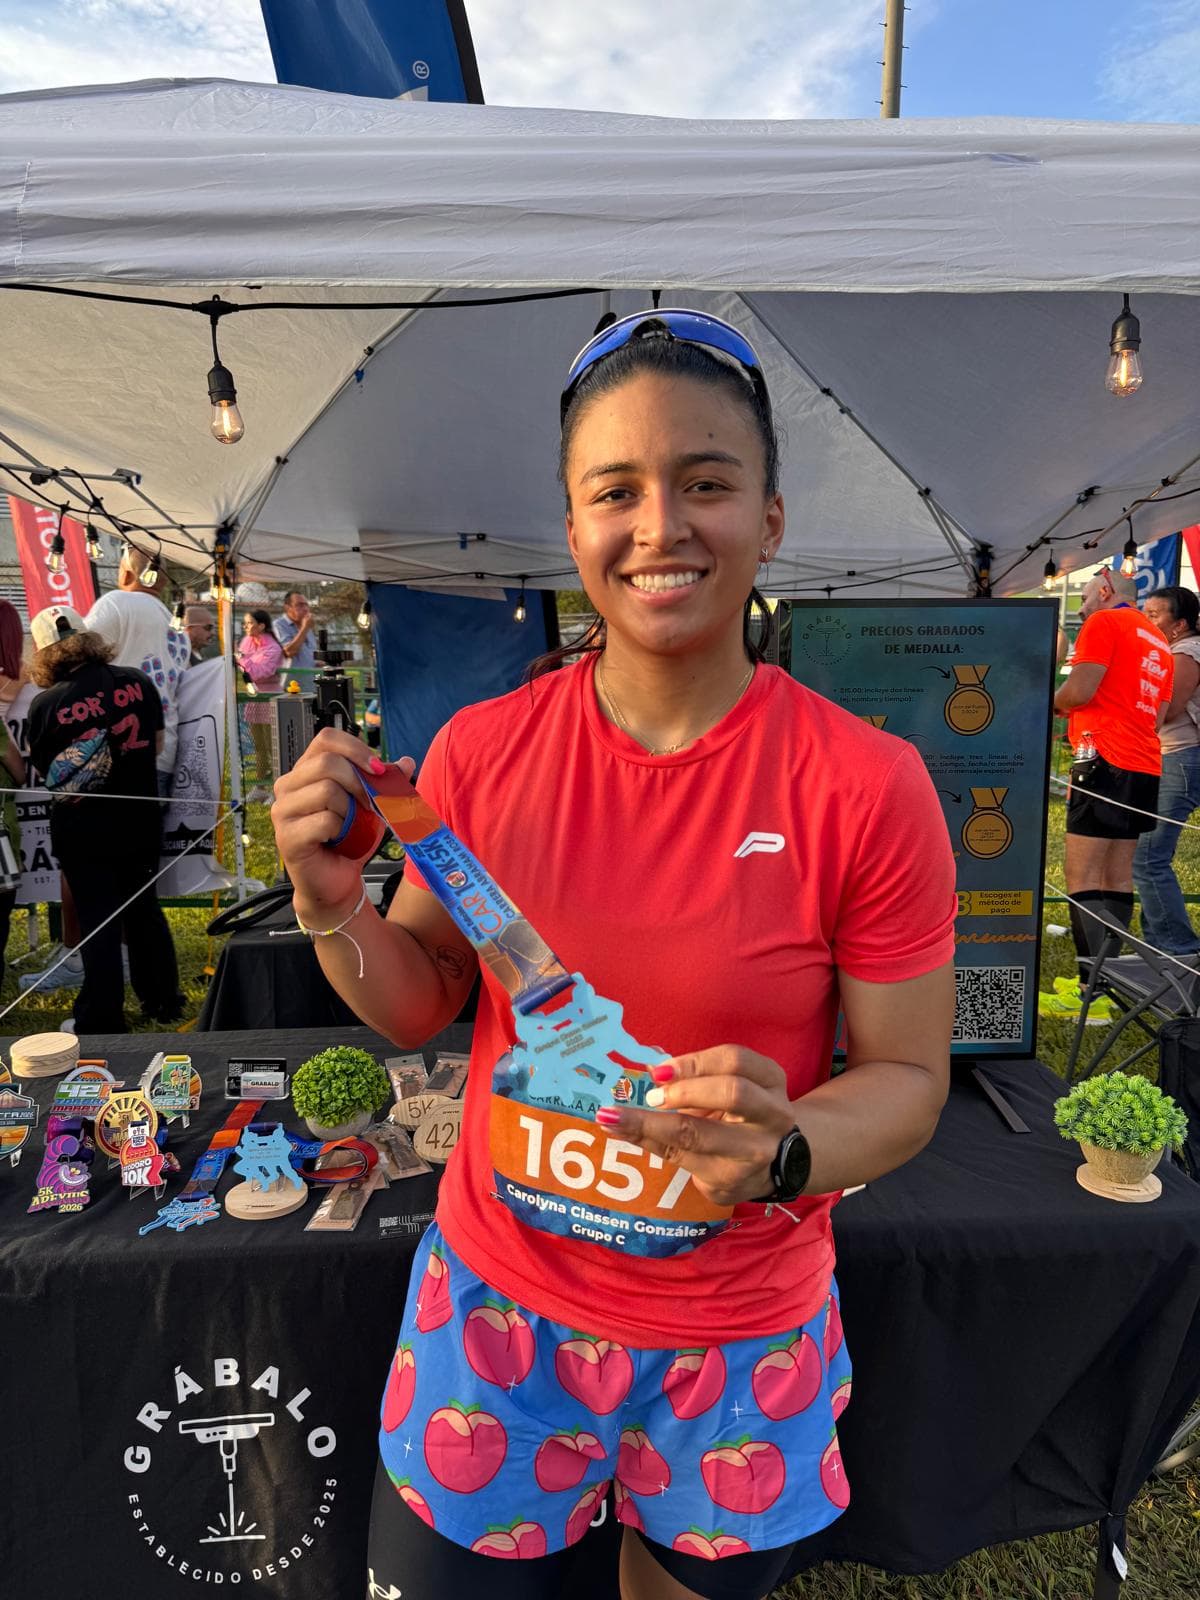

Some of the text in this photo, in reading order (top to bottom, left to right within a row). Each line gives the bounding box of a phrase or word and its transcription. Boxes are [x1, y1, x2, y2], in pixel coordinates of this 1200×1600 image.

[861, 625, 985, 637] PRECIOS GRABADOS
[884, 643, 964, 654] DE MEDALLA:
[28, 805, 47, 817] EN
[35, 826, 51, 836] TIE
[443, 834, 516, 919] CARRERA ABRAHAM ROSA
[462, 891, 502, 933] CAR
[990, 907, 1011, 915] pago
[407, 1098, 435, 1119] 5K
[425, 1122, 462, 1149] 42
[520, 1115, 692, 1209] 1657
[123, 1167, 151, 1185] 10K
[37, 1186, 54, 1197] 5K
[506, 1183, 707, 1239] Carolyna Classen González
[571, 1223, 626, 1246] Grupo C
[123, 1357, 337, 1474] GRÁBALO
[128, 1478, 338, 1584] ESTABLECIDO DESDE 2025
